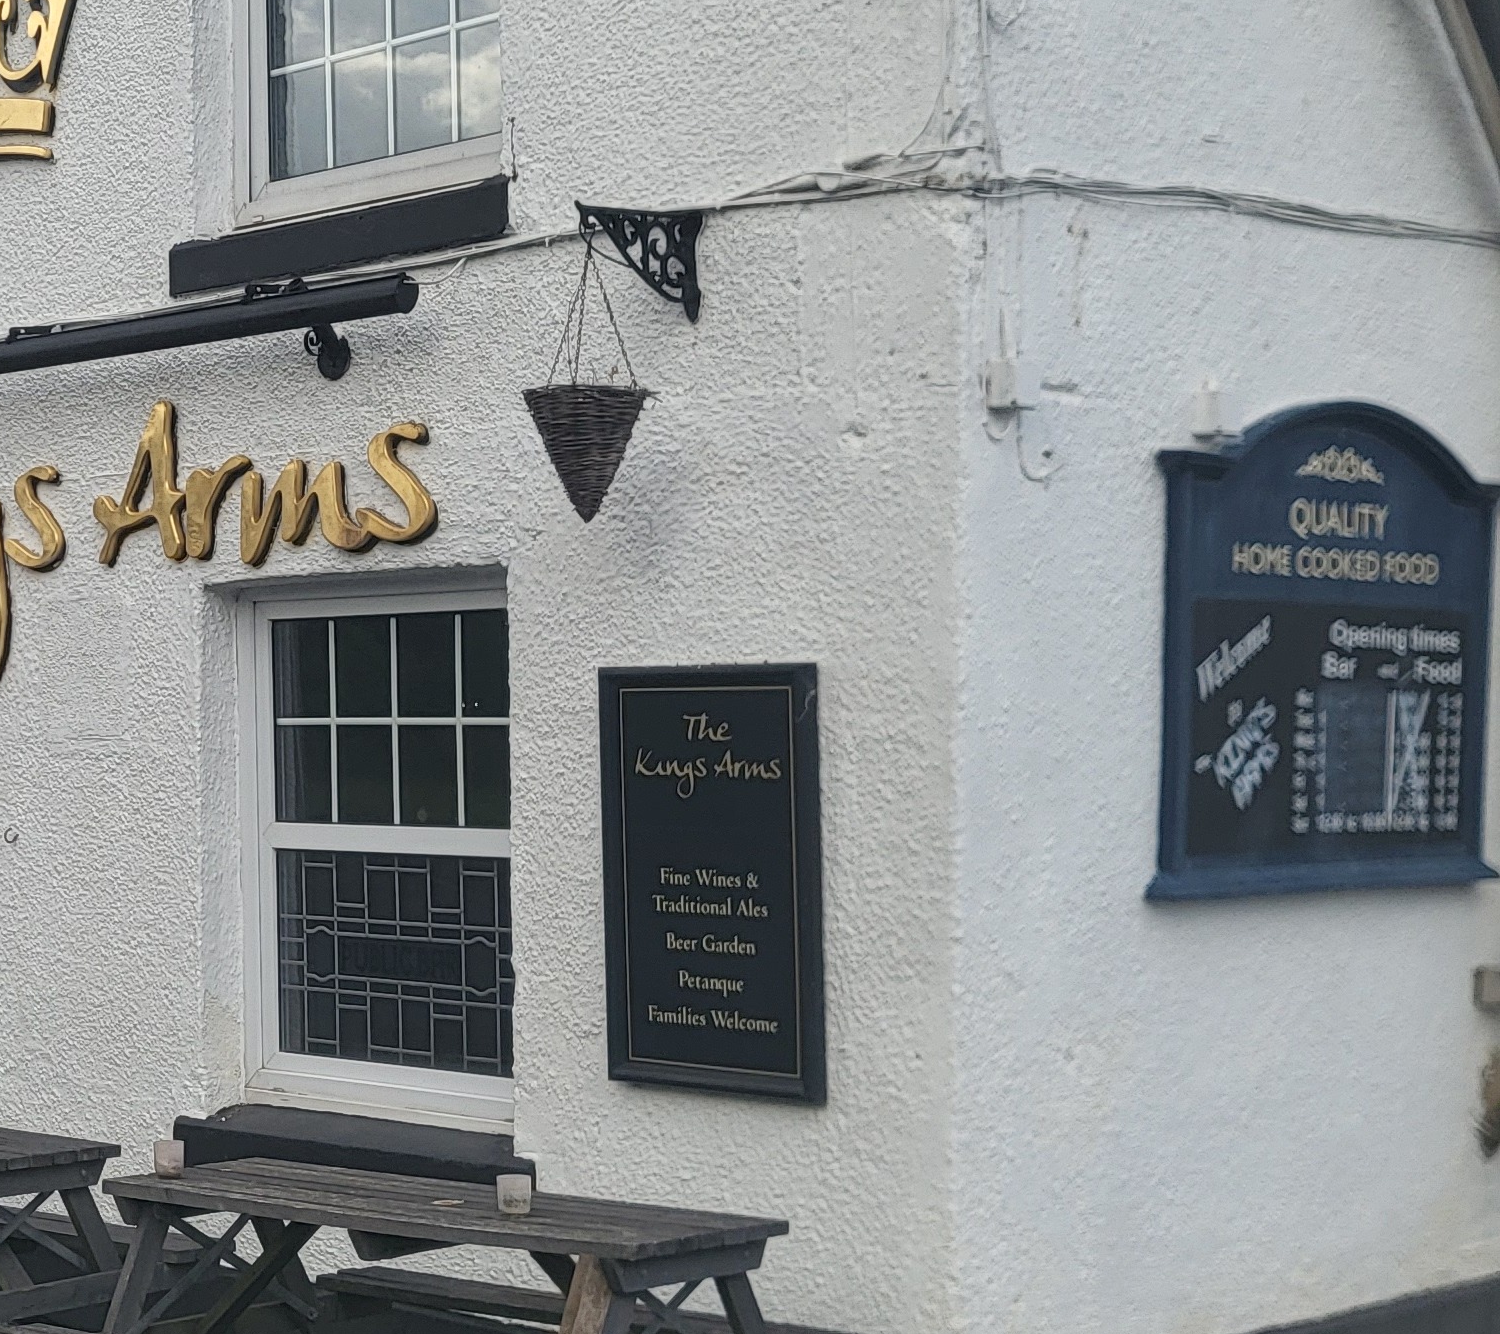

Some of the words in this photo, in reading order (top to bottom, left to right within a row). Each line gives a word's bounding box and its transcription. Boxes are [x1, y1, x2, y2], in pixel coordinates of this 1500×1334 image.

[92, 398, 439, 567] Arms
[1288, 497, 1389, 541] QUALITY
[1231, 541, 1293, 577] HOME
[1296, 545, 1381, 583] COOKED
[1381, 551, 1440, 586] FOOD
[1328, 619, 1408, 656] Opening
[1408, 623, 1461, 654] times
[1321, 650, 1357, 680] Bar
[1412, 655, 1463, 685] Food
[683, 712, 732, 741] The
[635, 748, 707, 799] Kings
[713, 750, 781, 780] Arms
[660, 867, 691, 886] Fine
[695, 869, 742, 888] Wines
[746, 872, 759, 889] &
[651, 894, 732, 916] Traditional
[736, 898, 768, 918] Ales
[666, 932, 698, 951] Beer
[702, 934, 756, 955] Garden
[678, 970, 744, 998] Petanque
[648, 1004, 706, 1026] Families
[710, 1010, 778, 1033] Welcome
